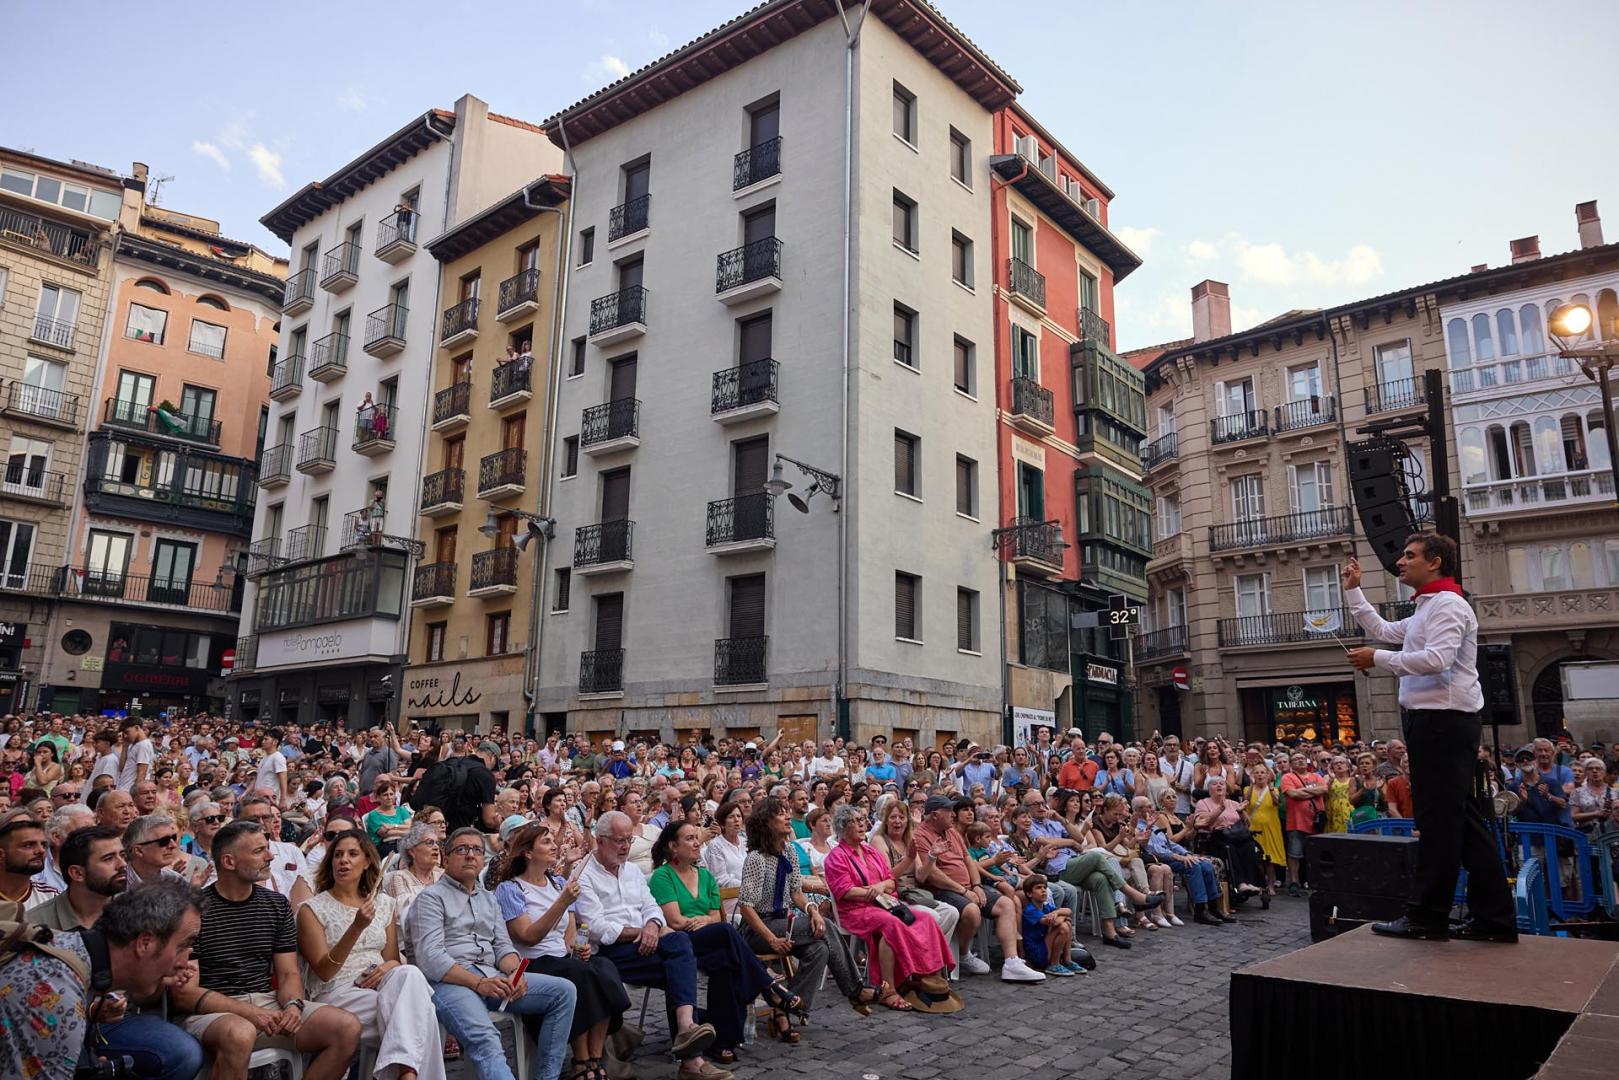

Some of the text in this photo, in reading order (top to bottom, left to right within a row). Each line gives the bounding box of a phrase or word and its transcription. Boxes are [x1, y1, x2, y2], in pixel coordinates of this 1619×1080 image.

[1110, 608, 1136, 623] 32°
[67, 670, 76, 680] 2
[1087, 664, 1116, 683] FARMACIA
[408, 671, 482, 709] nails
[410, 678, 439, 689] COFFEE
[1276, 699, 1317, 709] TABERNA
